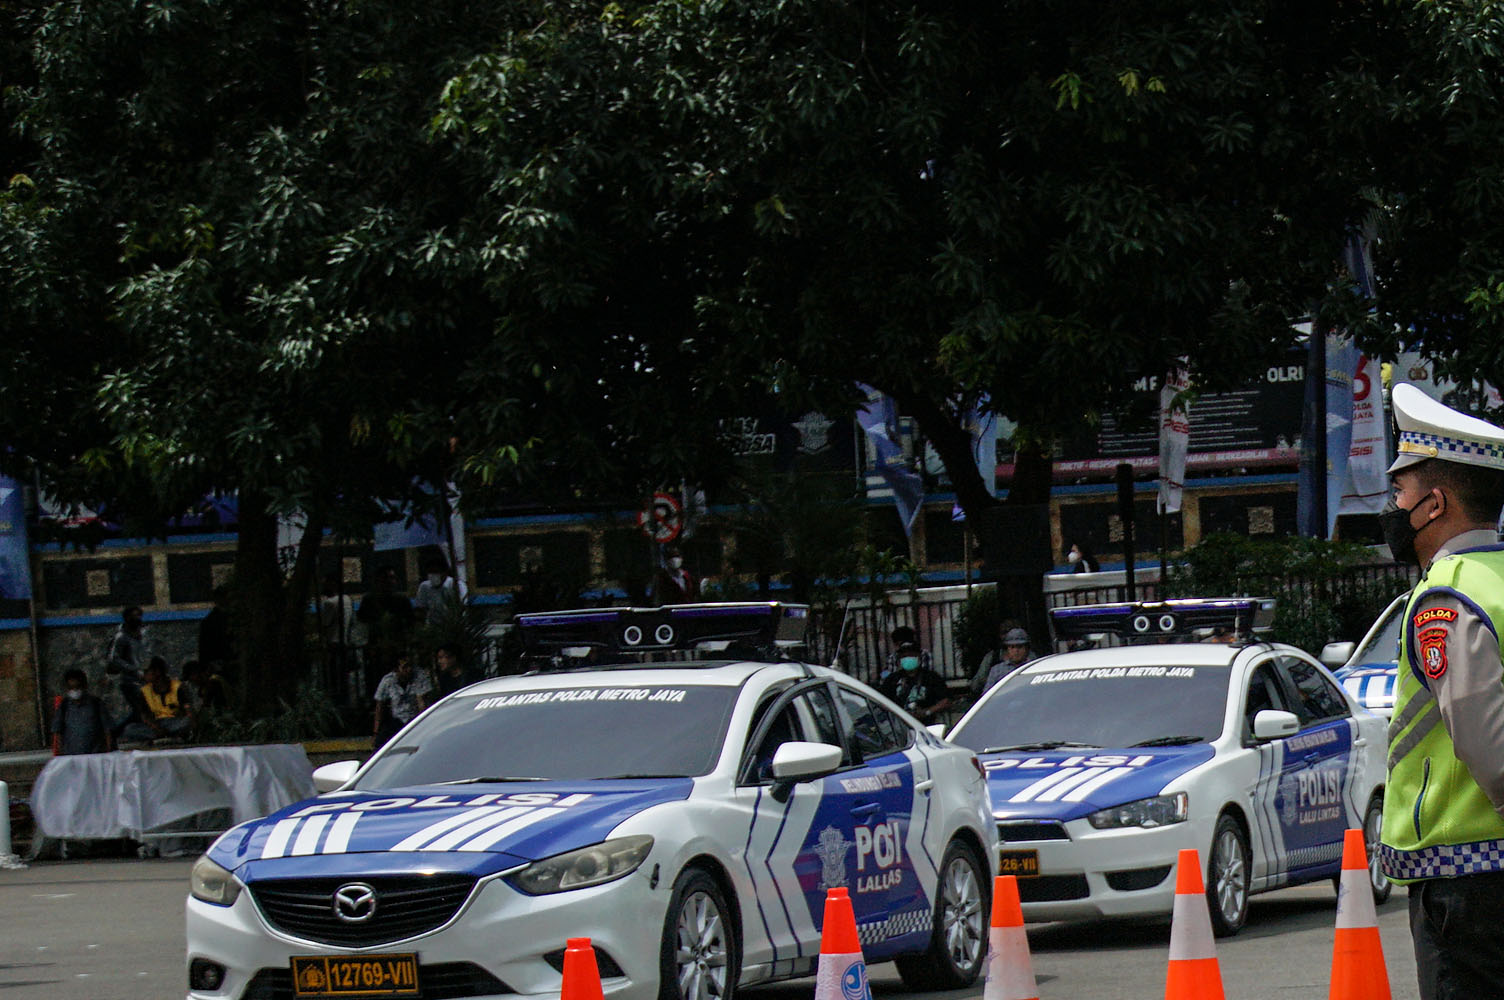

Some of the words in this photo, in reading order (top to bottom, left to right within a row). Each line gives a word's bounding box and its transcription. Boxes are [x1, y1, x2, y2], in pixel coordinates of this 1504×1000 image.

[1416, 608, 1452, 625] POLDA
[1089, 668, 1127, 679] POLDA
[1126, 667, 1166, 678] METRO
[1165, 667, 1195, 678] JAYA
[474, 692, 553, 711] DITLANTAS
[550, 689, 600, 702] POLDA
[597, 688, 651, 701] METRO
[648, 689, 687, 703] JAYA
[982, 755, 1154, 770] OLISI
[1298, 770, 1341, 809] POLISI
[288, 793, 592, 818] POLISI
[331, 961, 414, 987] 12769-VII
